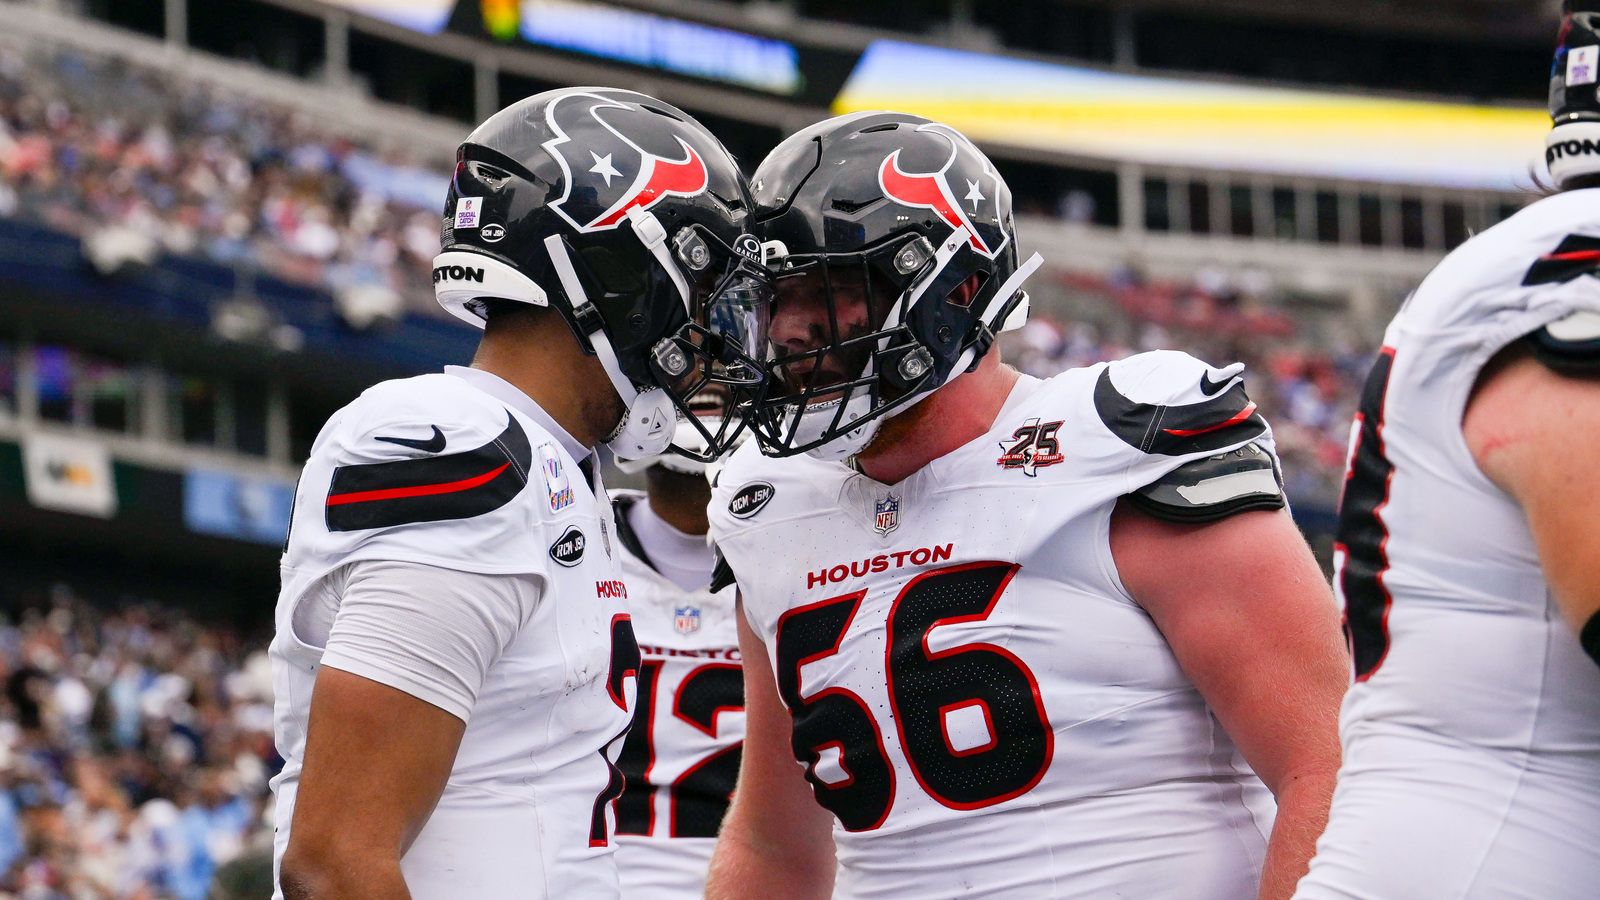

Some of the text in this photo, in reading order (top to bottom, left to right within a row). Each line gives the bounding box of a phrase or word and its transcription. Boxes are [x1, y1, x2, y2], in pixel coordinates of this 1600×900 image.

[736, 246, 761, 263] OAKLEY
[1004, 420, 1065, 468] 25
[732, 487, 771, 513] RCM JSM
[877, 511, 896, 530] NFL
[556, 540, 574, 557] RCM
[807, 543, 954, 590] HOUSTON
[776, 560, 1055, 833] 56
